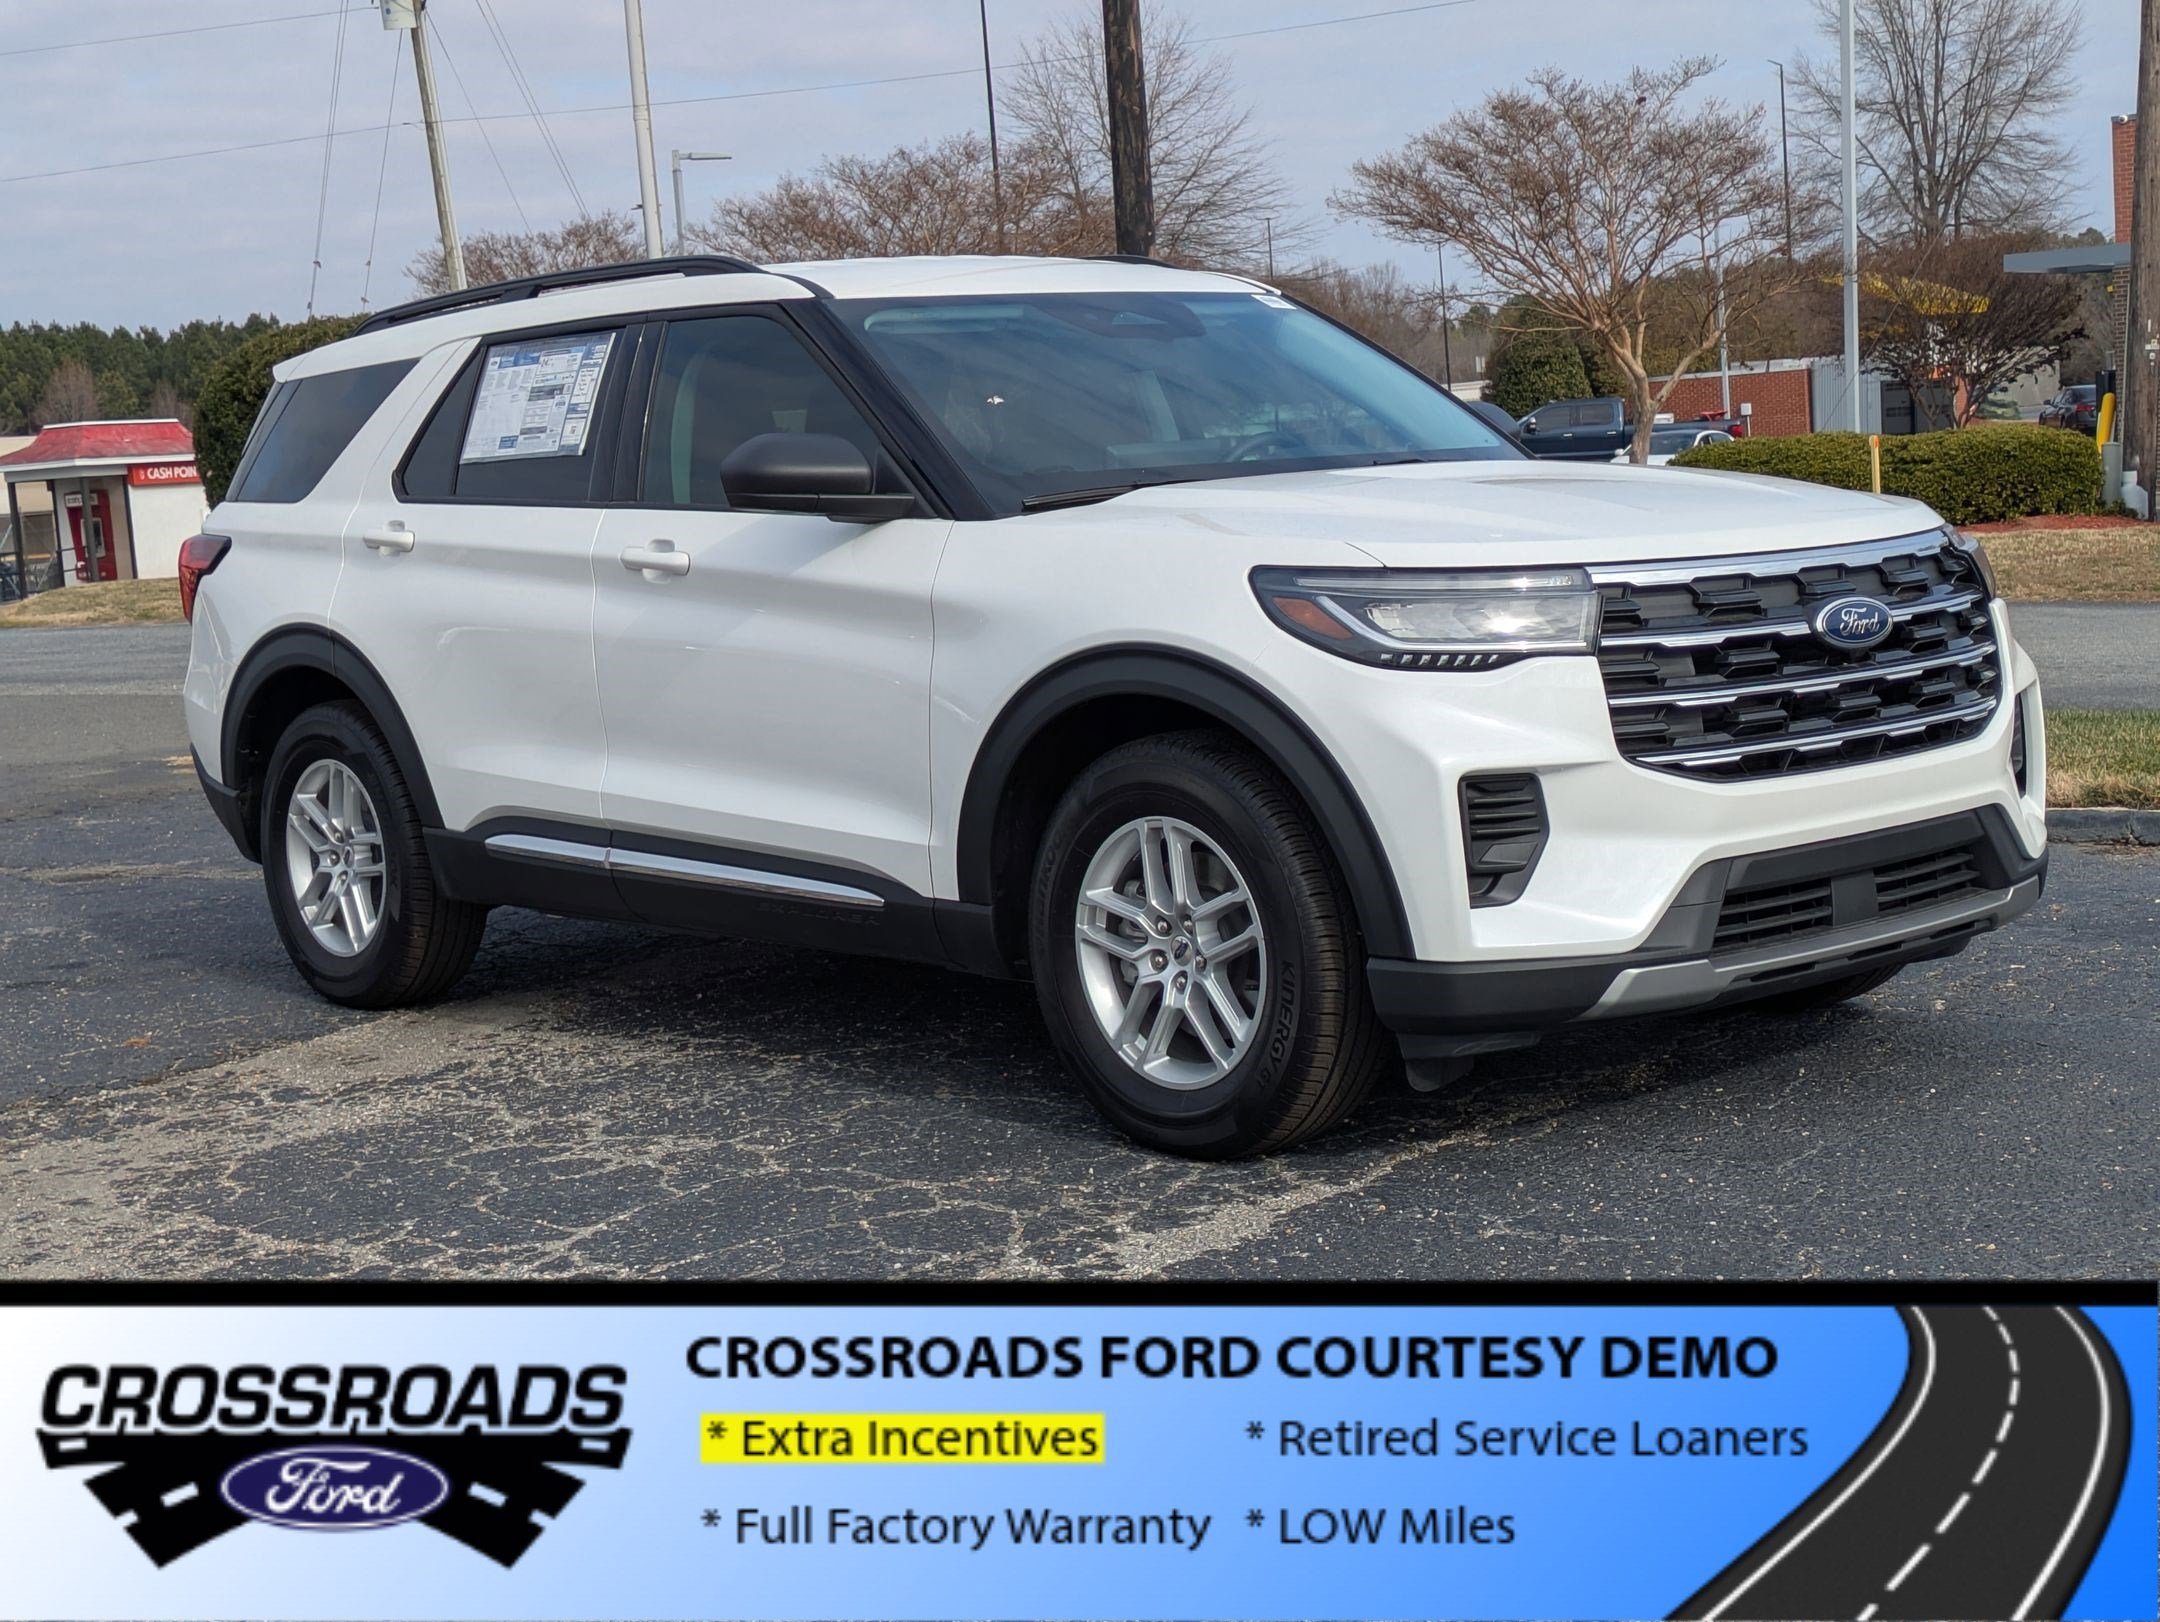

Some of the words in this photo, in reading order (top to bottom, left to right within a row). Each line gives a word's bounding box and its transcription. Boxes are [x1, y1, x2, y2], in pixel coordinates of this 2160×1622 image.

[147, 467, 173, 480] CASH
[174, 466, 197, 478] POIN
[1840, 607, 1880, 636] Ford
[1269, 960, 1296, 1074] KINERGY
